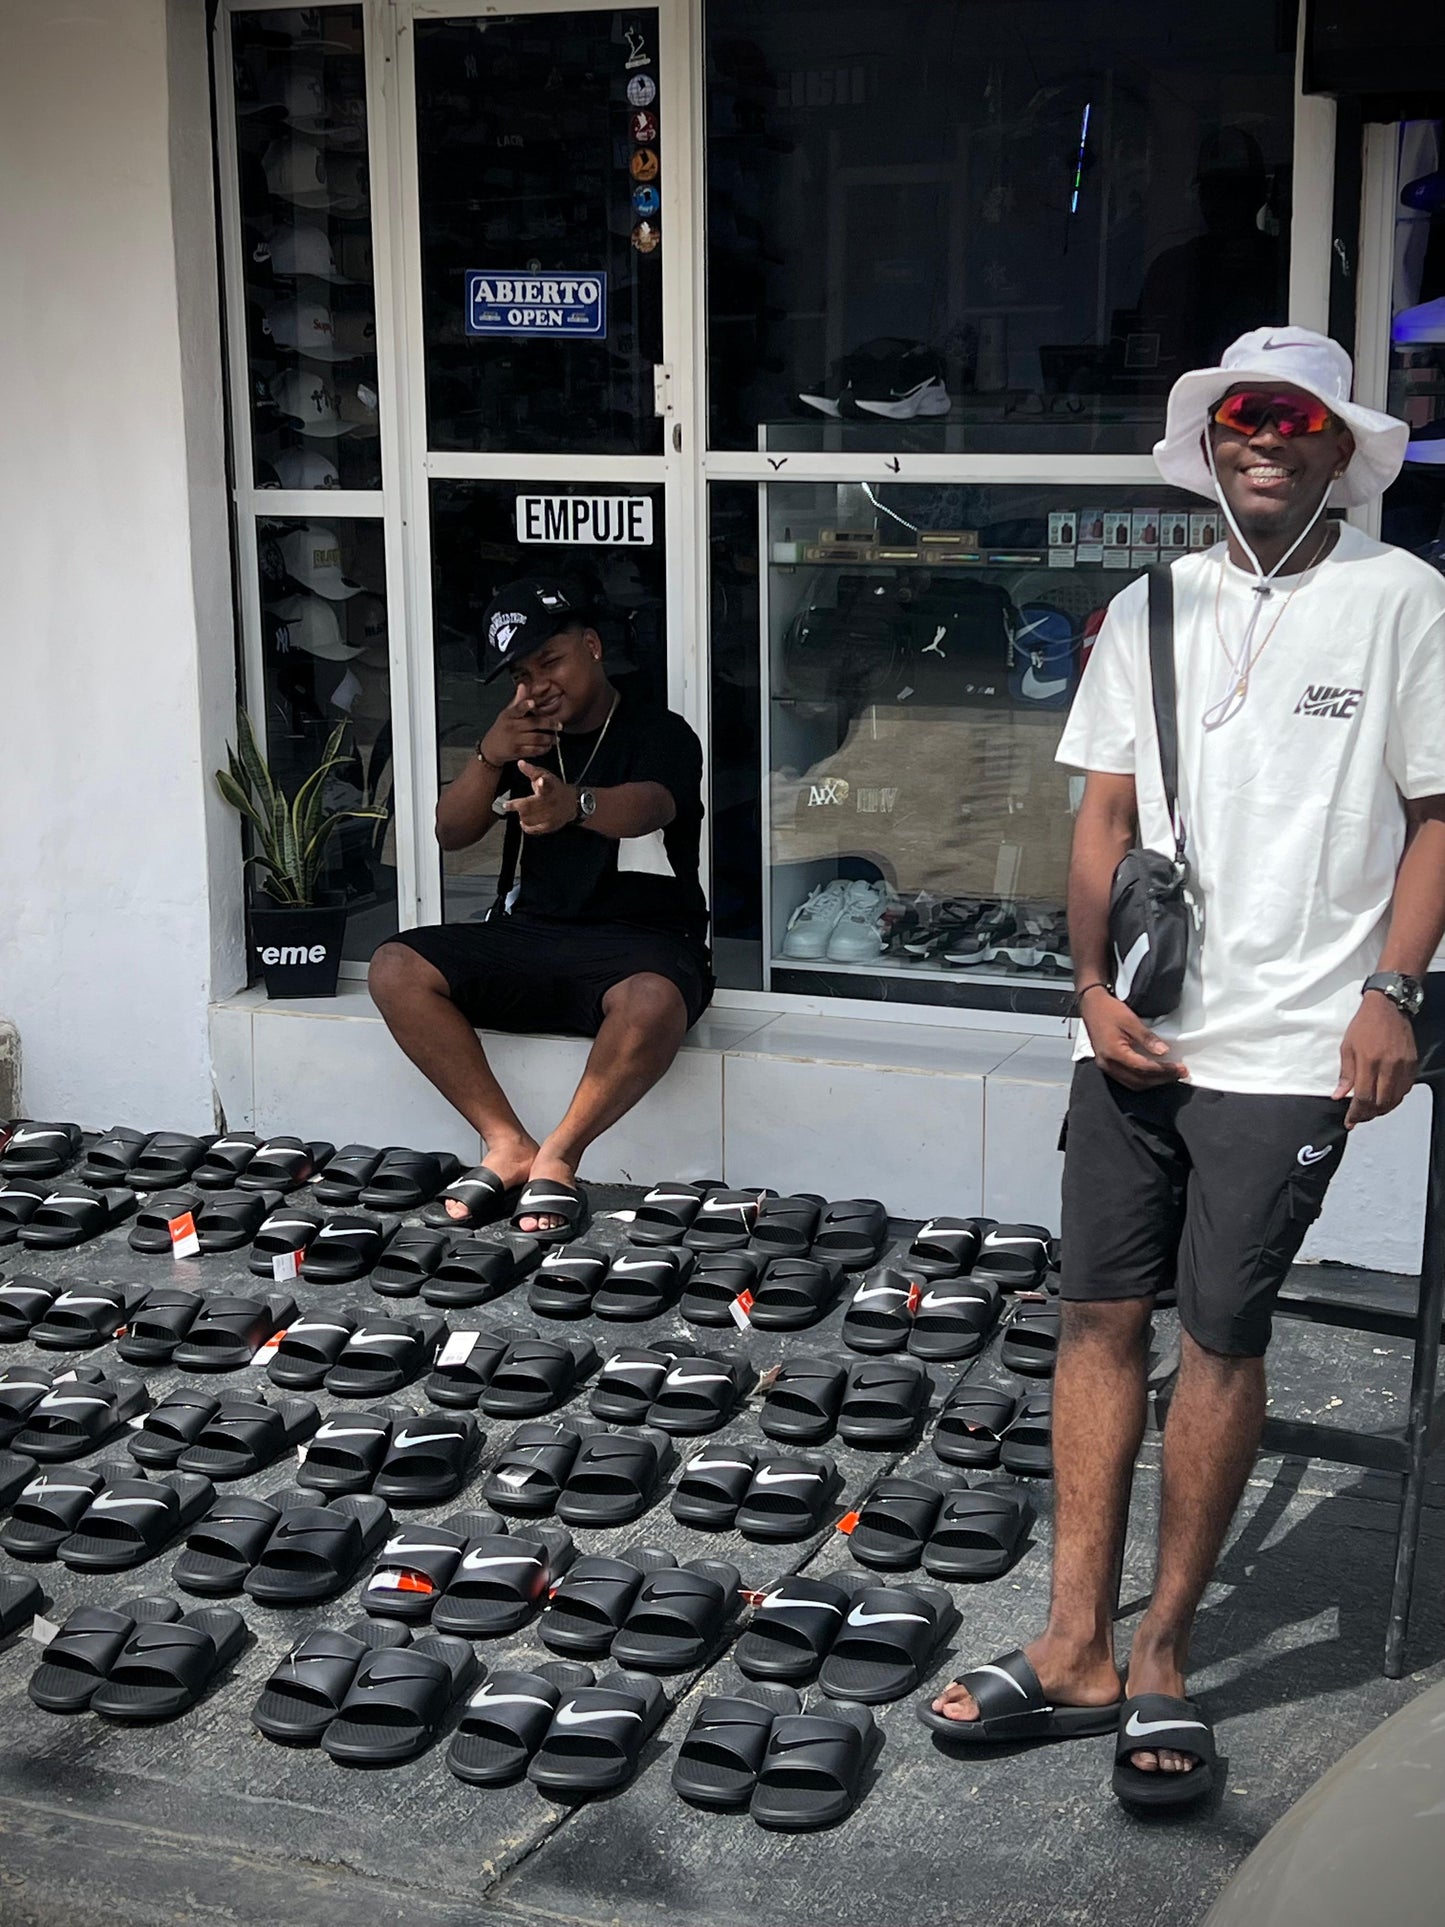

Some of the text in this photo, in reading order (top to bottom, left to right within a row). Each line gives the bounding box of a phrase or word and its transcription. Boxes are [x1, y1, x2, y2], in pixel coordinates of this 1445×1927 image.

[475, 281, 598, 304] ABIERTO
[507, 309, 563, 326] OPEN
[526, 499, 645, 542] EMPUJE
[1294, 685, 1364, 719] NIKE
[256, 945, 327, 966] eme
